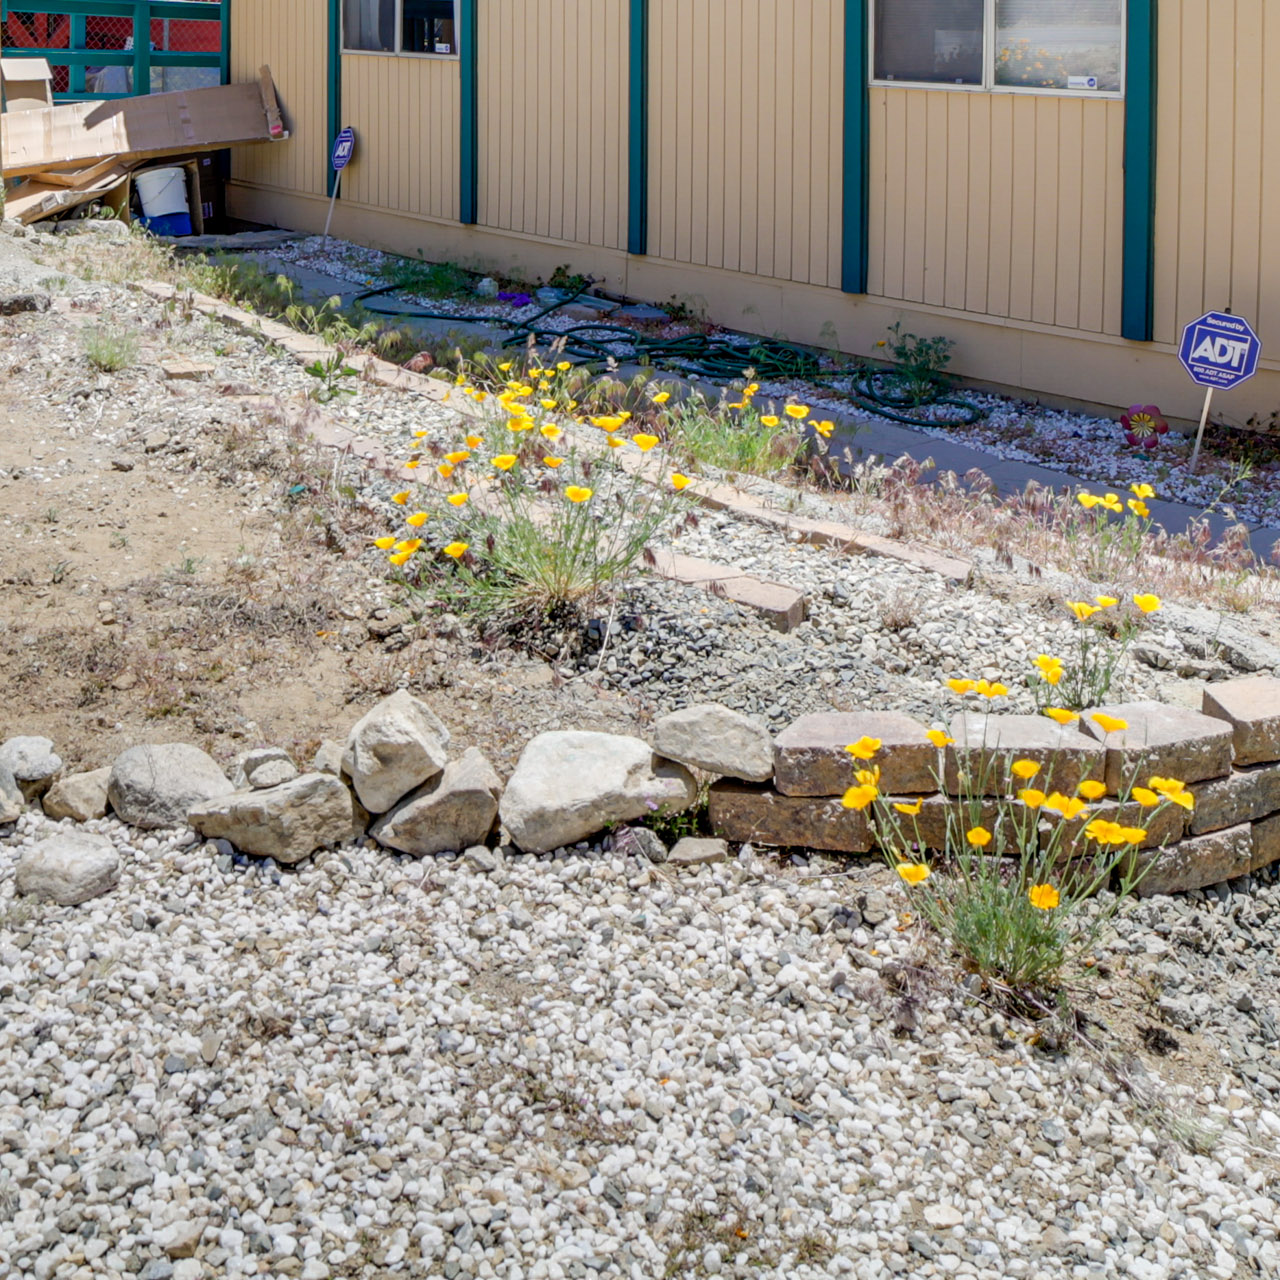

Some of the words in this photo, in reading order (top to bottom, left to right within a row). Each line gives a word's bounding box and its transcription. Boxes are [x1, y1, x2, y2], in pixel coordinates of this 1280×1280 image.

[335, 141, 351, 157] ADT
[1206, 317, 1236, 328] Secured
[1236, 323, 1245, 332] by
[1192, 335, 1248, 367] ADT
